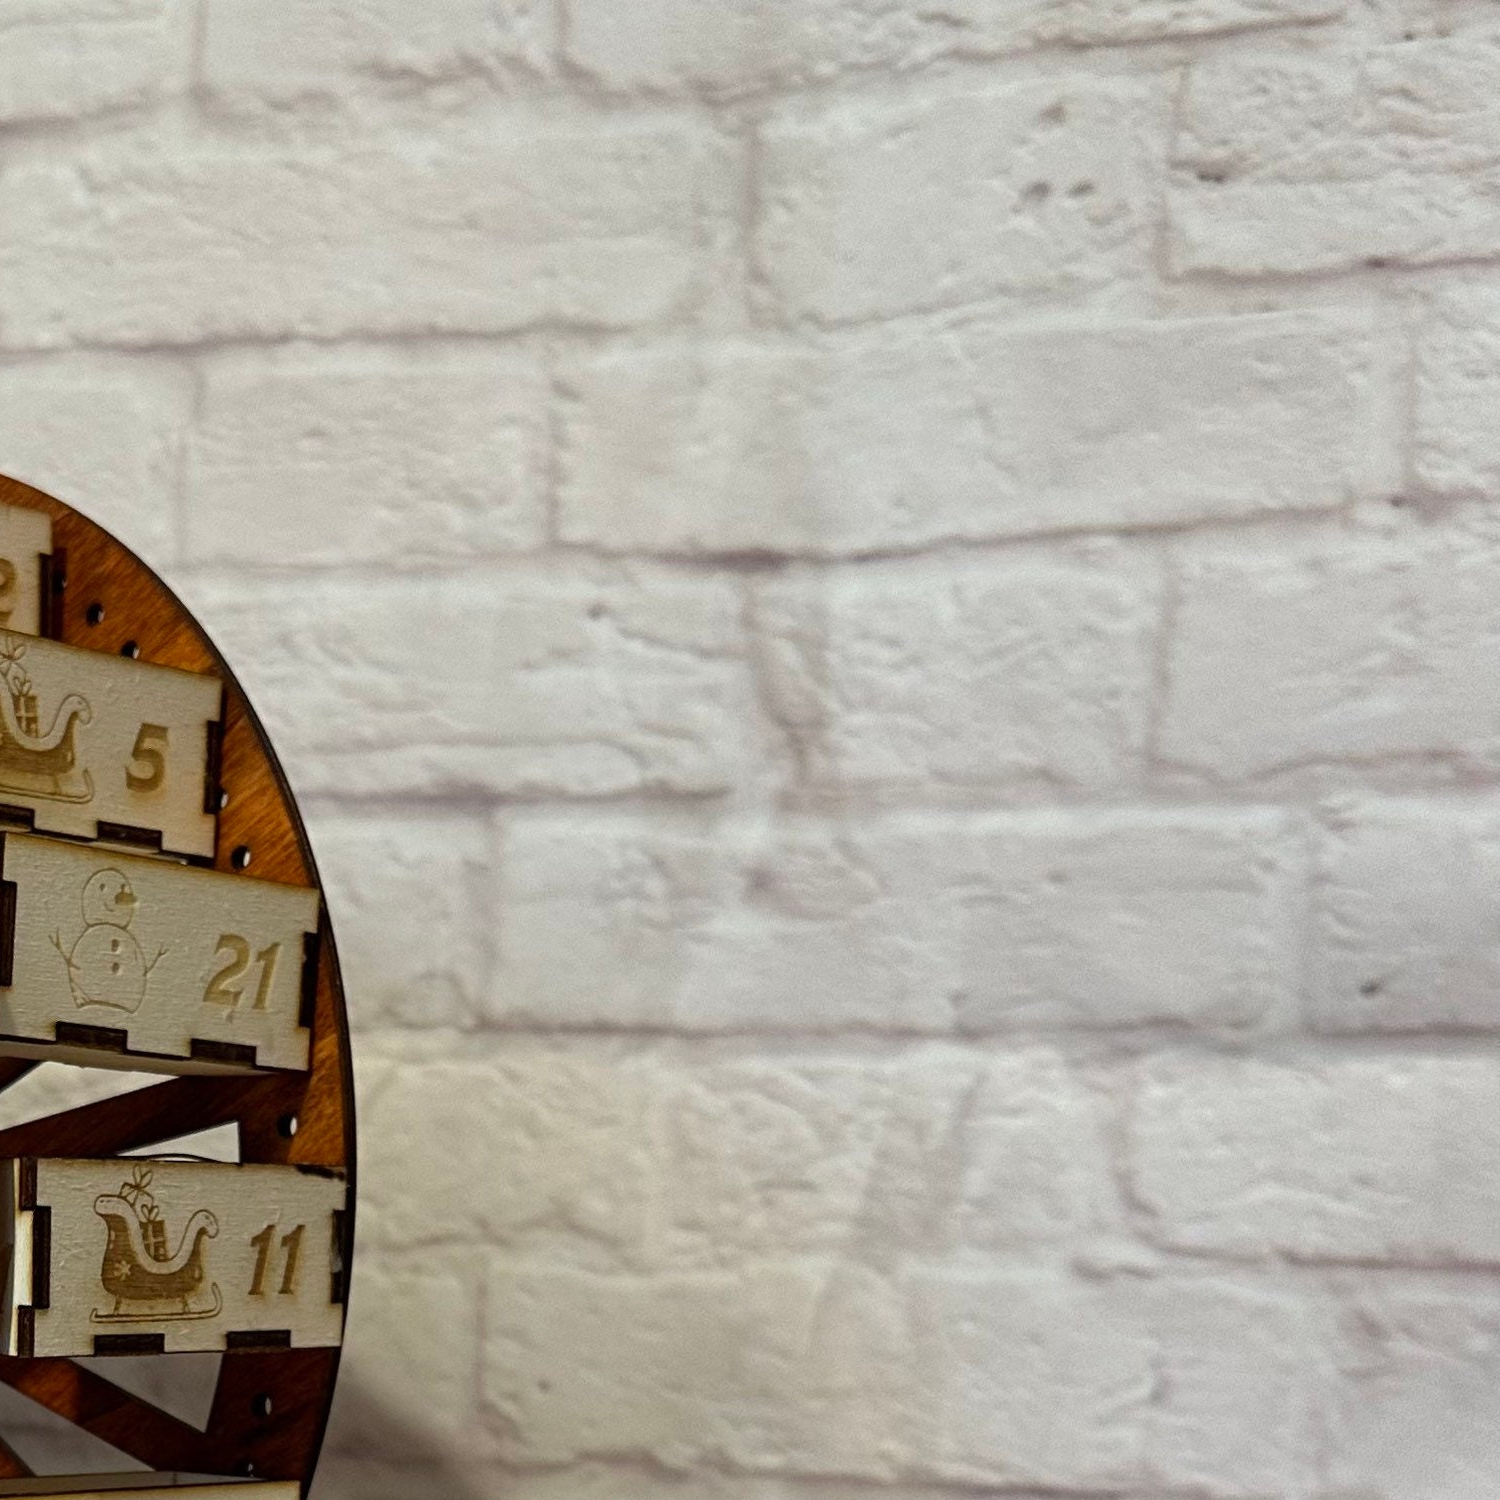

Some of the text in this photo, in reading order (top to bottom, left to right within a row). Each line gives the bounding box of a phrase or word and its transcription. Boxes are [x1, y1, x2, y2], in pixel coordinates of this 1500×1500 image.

[125, 722, 170, 793] 5
[203, 932, 283, 1012] 21
[248, 1223, 306, 1296] 11
